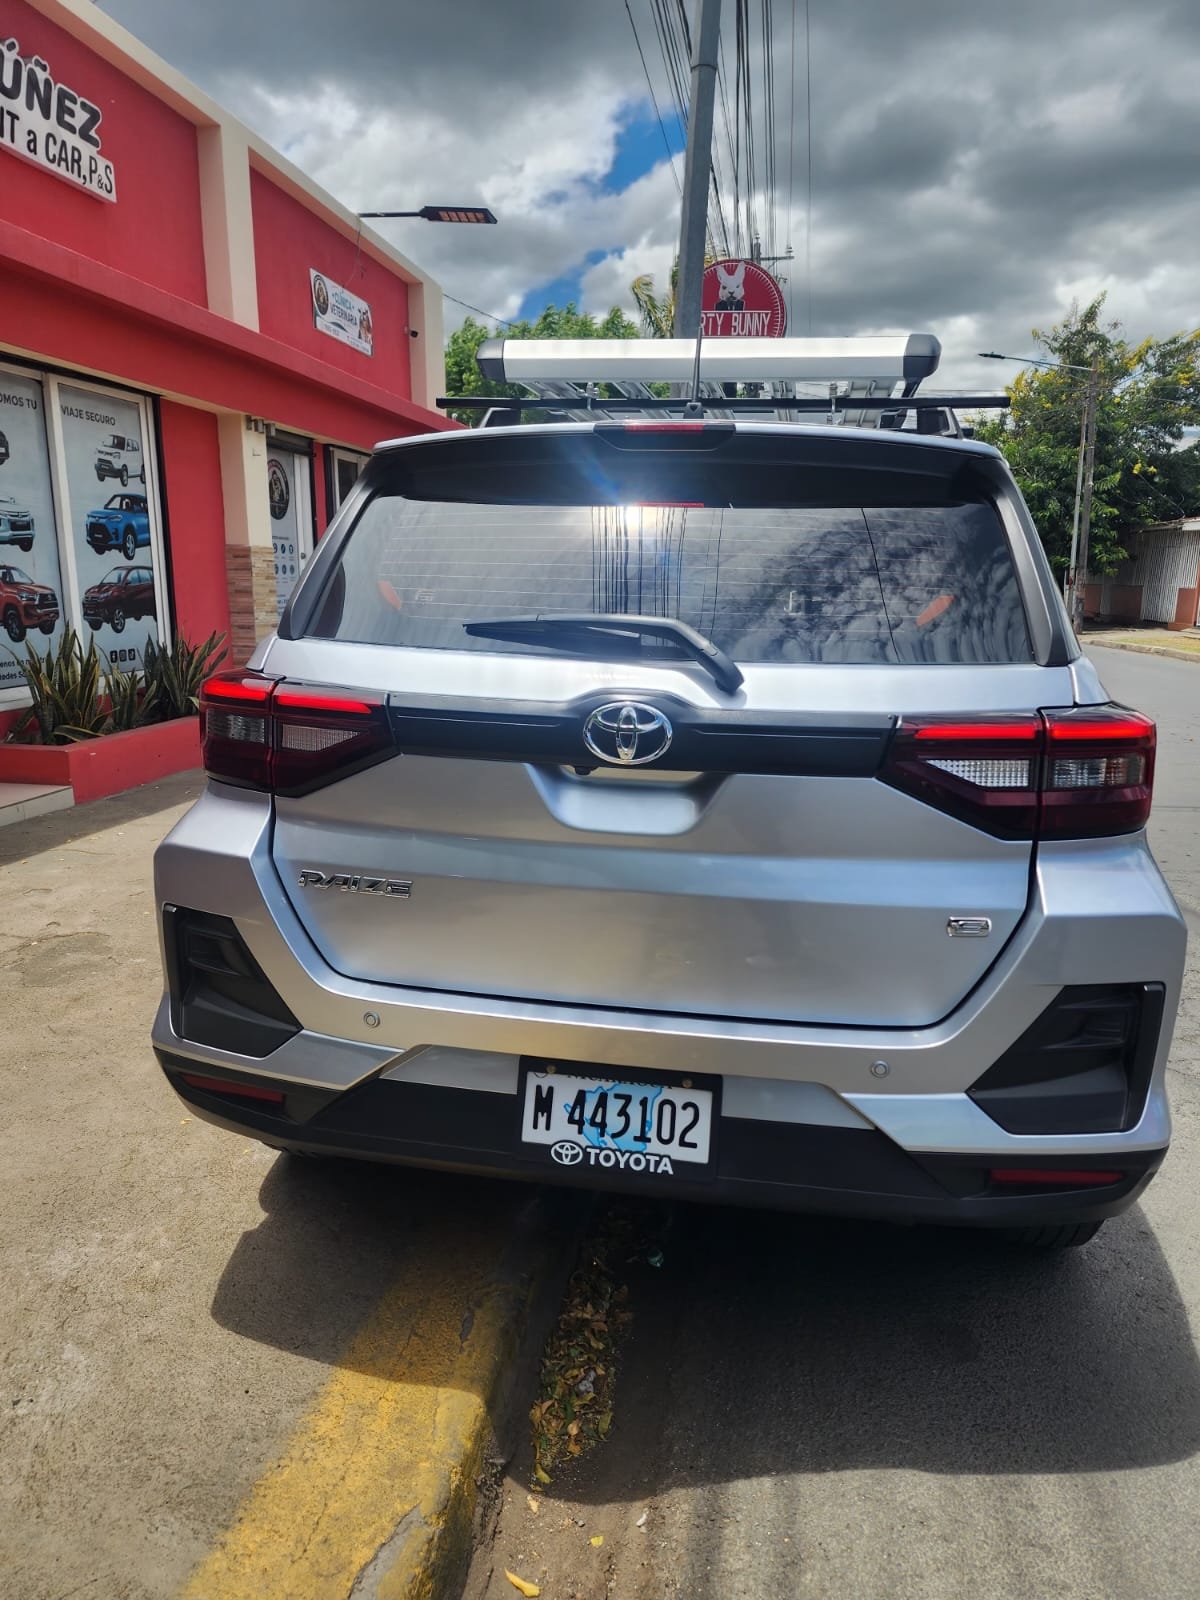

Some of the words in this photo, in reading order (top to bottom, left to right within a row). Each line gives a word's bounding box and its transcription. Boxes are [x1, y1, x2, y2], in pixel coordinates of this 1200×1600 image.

[27, 129, 38, 156] a
[731, 313, 771, 336] BUNNY
[25, 398, 37, 410] TU
[61, 404, 84, 420] VIAJE
[85, 411, 116, 426] SEGURO
[298, 869, 413, 898] RAIZE
[532, 1084, 554, 1131] M
[567, 1089, 700, 1149] 443102
[586, 1148, 674, 1175] TOYOTA
